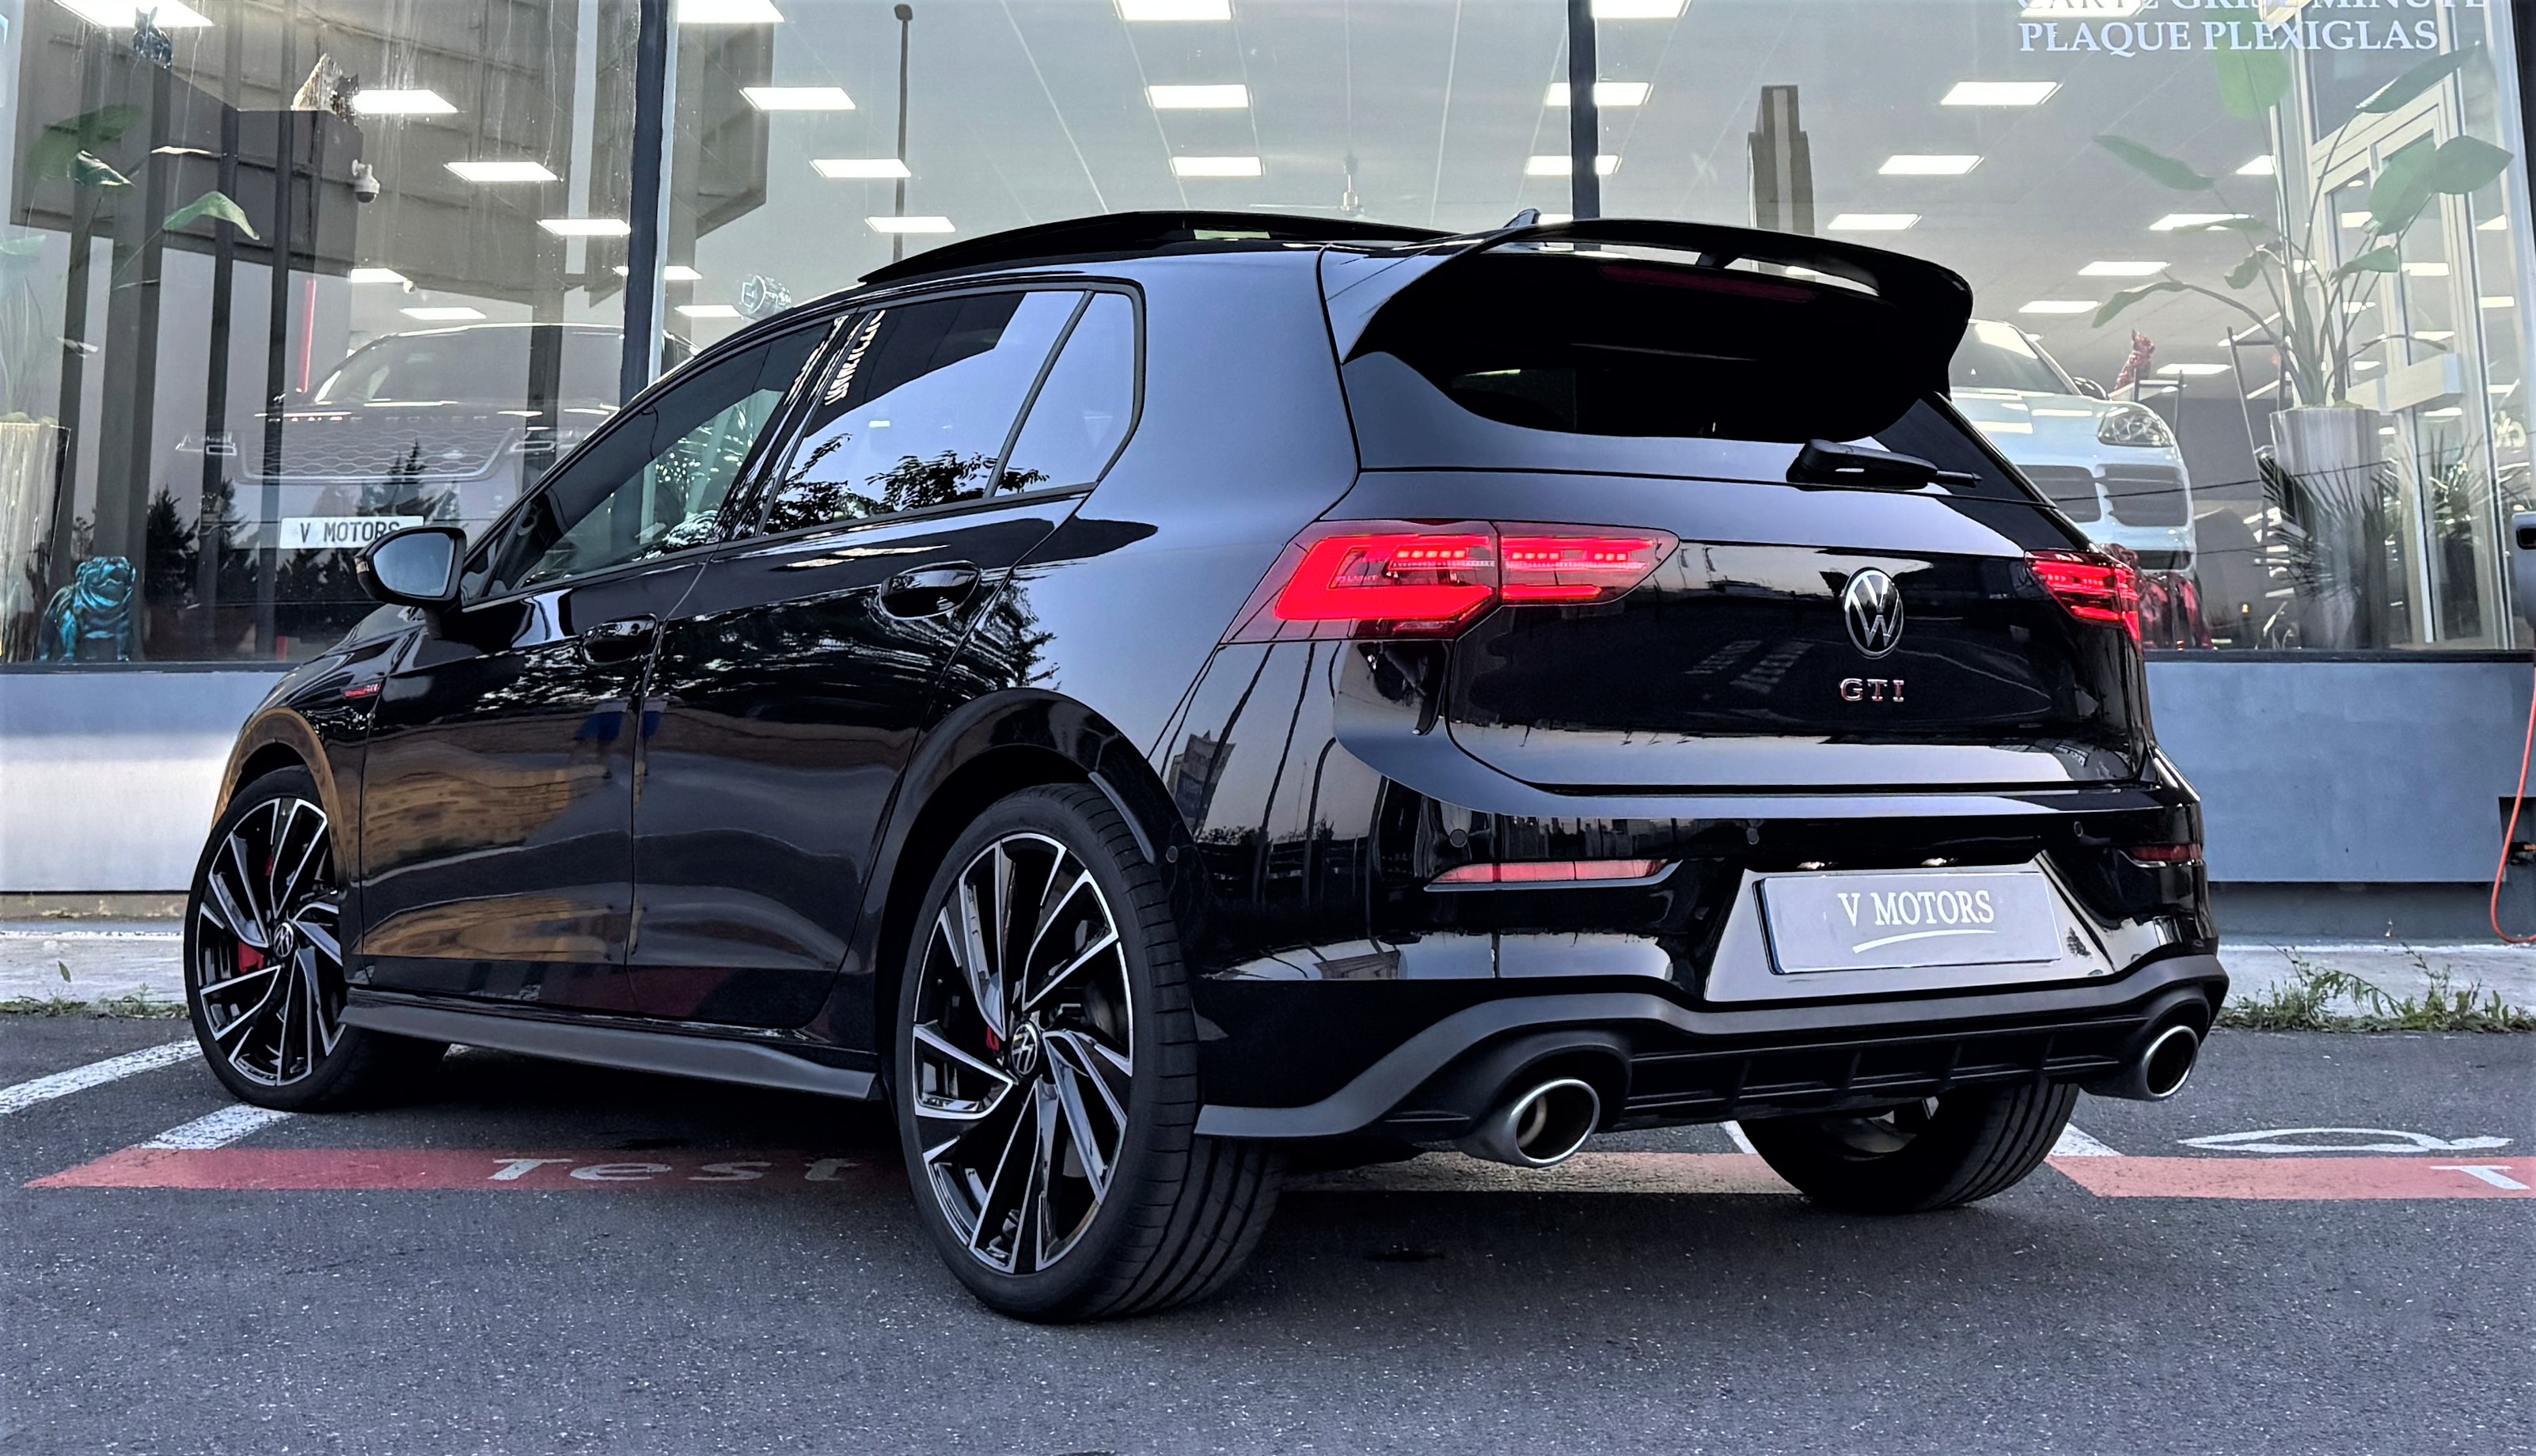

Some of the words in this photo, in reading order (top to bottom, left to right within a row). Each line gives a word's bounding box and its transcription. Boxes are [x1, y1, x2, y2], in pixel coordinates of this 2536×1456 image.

[2018, 21, 2192, 58] PLAQUE
[2201, 20, 2439, 51] PLEXIGLAS
[300, 522, 311, 543] V
[1839, 677, 1905, 702] GTI
[1837, 893, 1861, 927] V
[1870, 889, 1995, 926] MOTORS
[488, 1158, 861, 1181] Test
